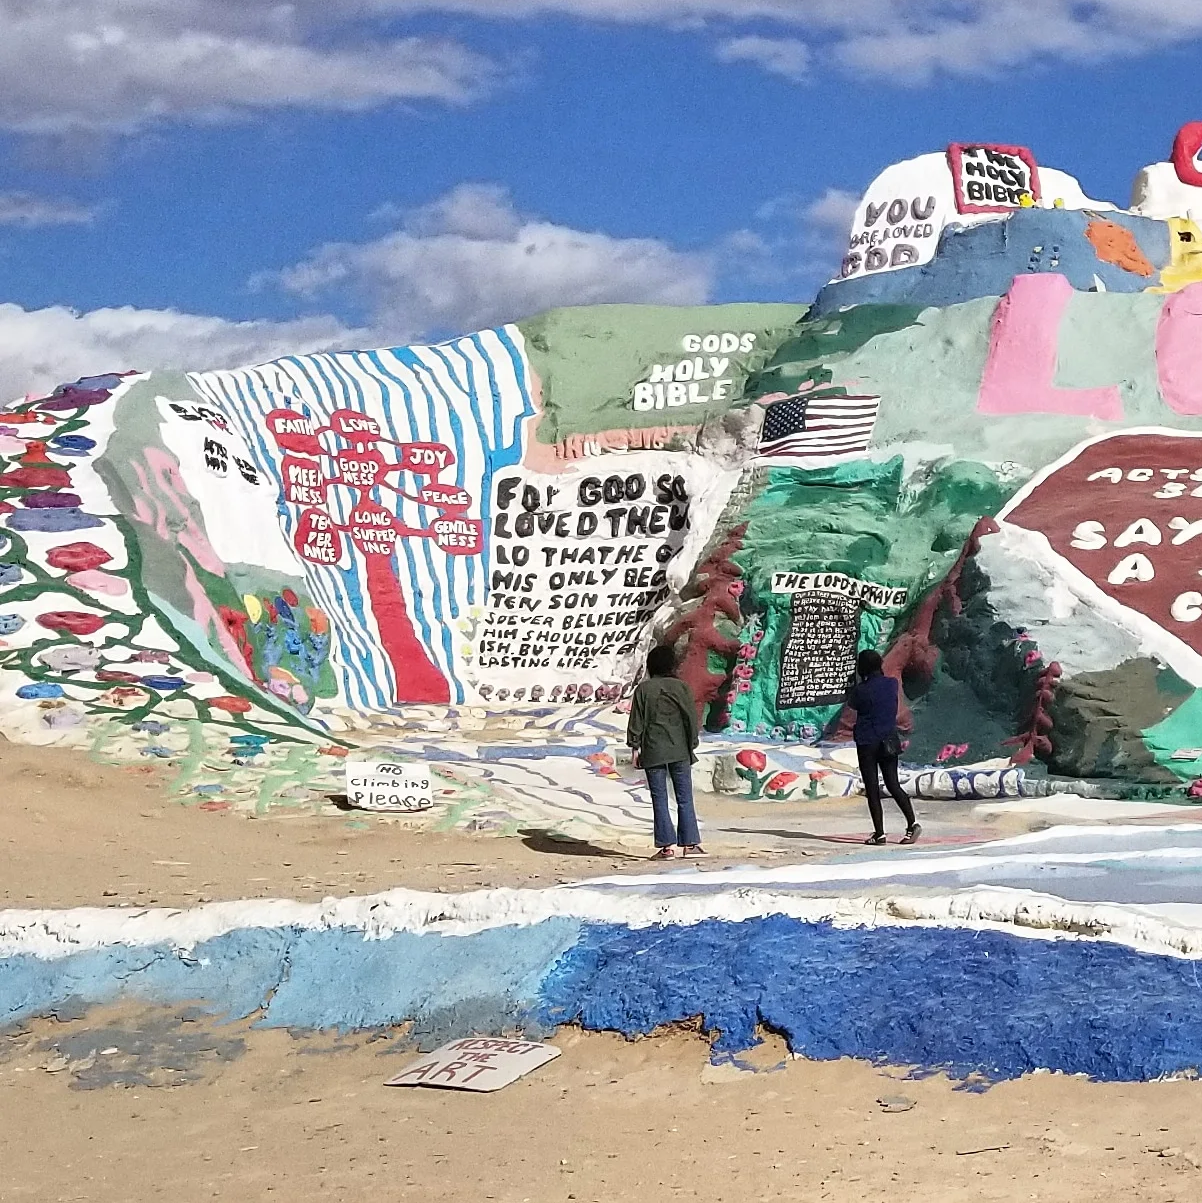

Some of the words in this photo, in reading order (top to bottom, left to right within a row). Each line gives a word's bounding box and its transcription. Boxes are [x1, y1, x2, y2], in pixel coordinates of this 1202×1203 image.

[965, 162, 1025, 188] HOLY
[864, 196, 937, 227] YOU
[878, 223, 933, 245] LOVED
[841, 244, 919, 278] GOD
[682, 333, 756, 353] GODS
[650, 357, 728, 383] HOLY
[631, 379, 732, 411] BIBLE
[274, 418, 315, 435] FAITH
[339, 417, 379, 434] LOVE
[340, 458, 379, 474] GOOD
[410, 448, 447, 469] JOY
[343, 473, 375, 485] NESS
[290, 485, 323, 504] NESS
[422, 490, 468, 505] PEACE
[578, 473, 647, 507] GOD
[354, 511, 391, 525] LONG
[494, 511, 599, 539] LOVED
[353, 527, 396, 542] SUFFER
[434, 520, 478, 535] GENTLE
[308, 532, 332, 547] PER
[363, 542, 390, 554] ING
[438, 534, 477, 548] NESS
[303, 543, 337, 562] ANCE
[1107, 553, 1155, 584] A
[492, 570, 537, 593] HIS
[549, 568, 618, 591] ONLY
[776, 574, 809, 589] THE
[861, 584, 907, 606] PRAYER
[548, 593, 598, 610] SON
[484, 612, 554, 629] SOEVER
[483, 628, 518, 640] HIM
[522, 630, 597, 645] SHOULD
[519, 643, 559, 656] BUT
[565, 643, 616, 658] HAVE
[479, 656, 550, 669] LASTING
[380, 766, 403, 776] NO
[448, 1039, 544, 1055] RESPECT
[457, 1051, 498, 1063] THE
[392, 1061, 498, 1084] ART
